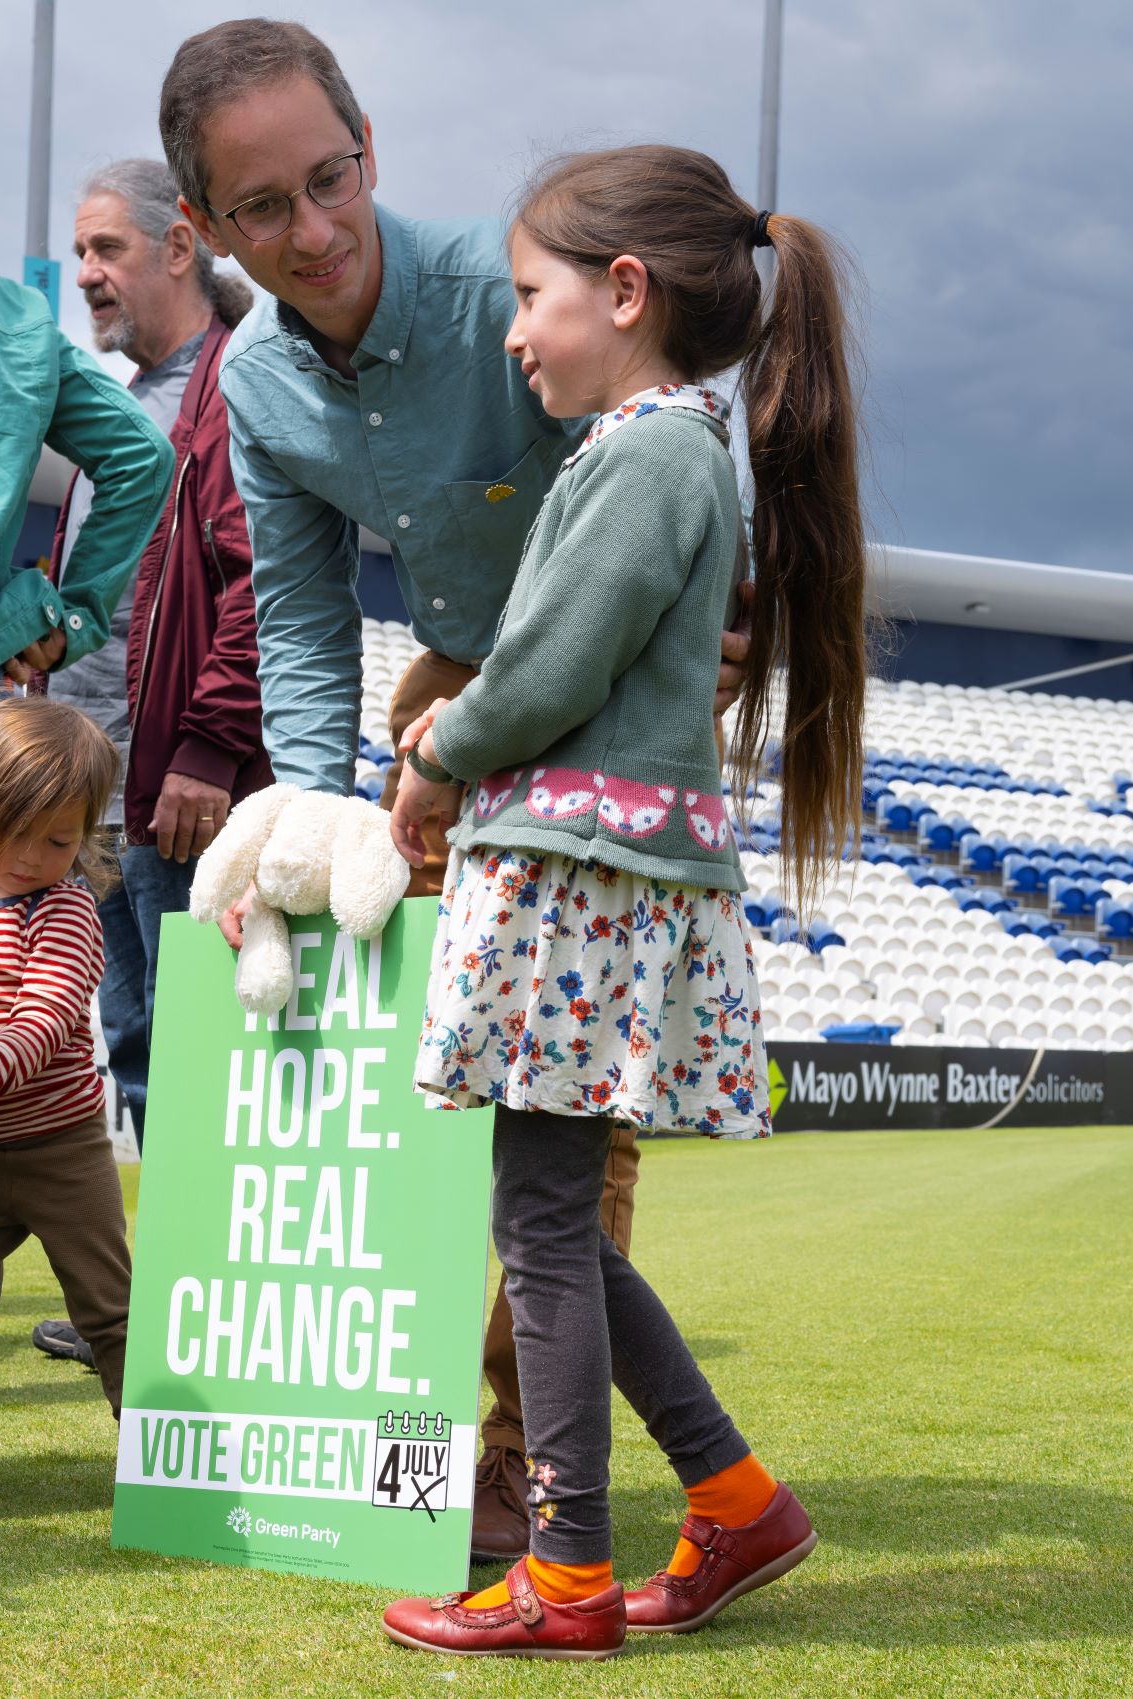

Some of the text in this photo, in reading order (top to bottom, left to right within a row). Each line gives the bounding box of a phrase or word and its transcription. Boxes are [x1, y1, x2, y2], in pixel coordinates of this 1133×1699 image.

[243, 932, 398, 1032] EAL
[224, 1047, 400, 1149] HOPE.
[790, 1060, 1104, 1117] Mayo Wynne Baxter Solicitors
[227, 1164, 383, 1270] REAL
[166, 1276, 431, 1396] CHANGE.
[140, 1417, 367, 1492] VOTE GREEN
[376, 1443, 447, 1503] 4 JULY
[255, 1518, 341, 1549] Green Party
